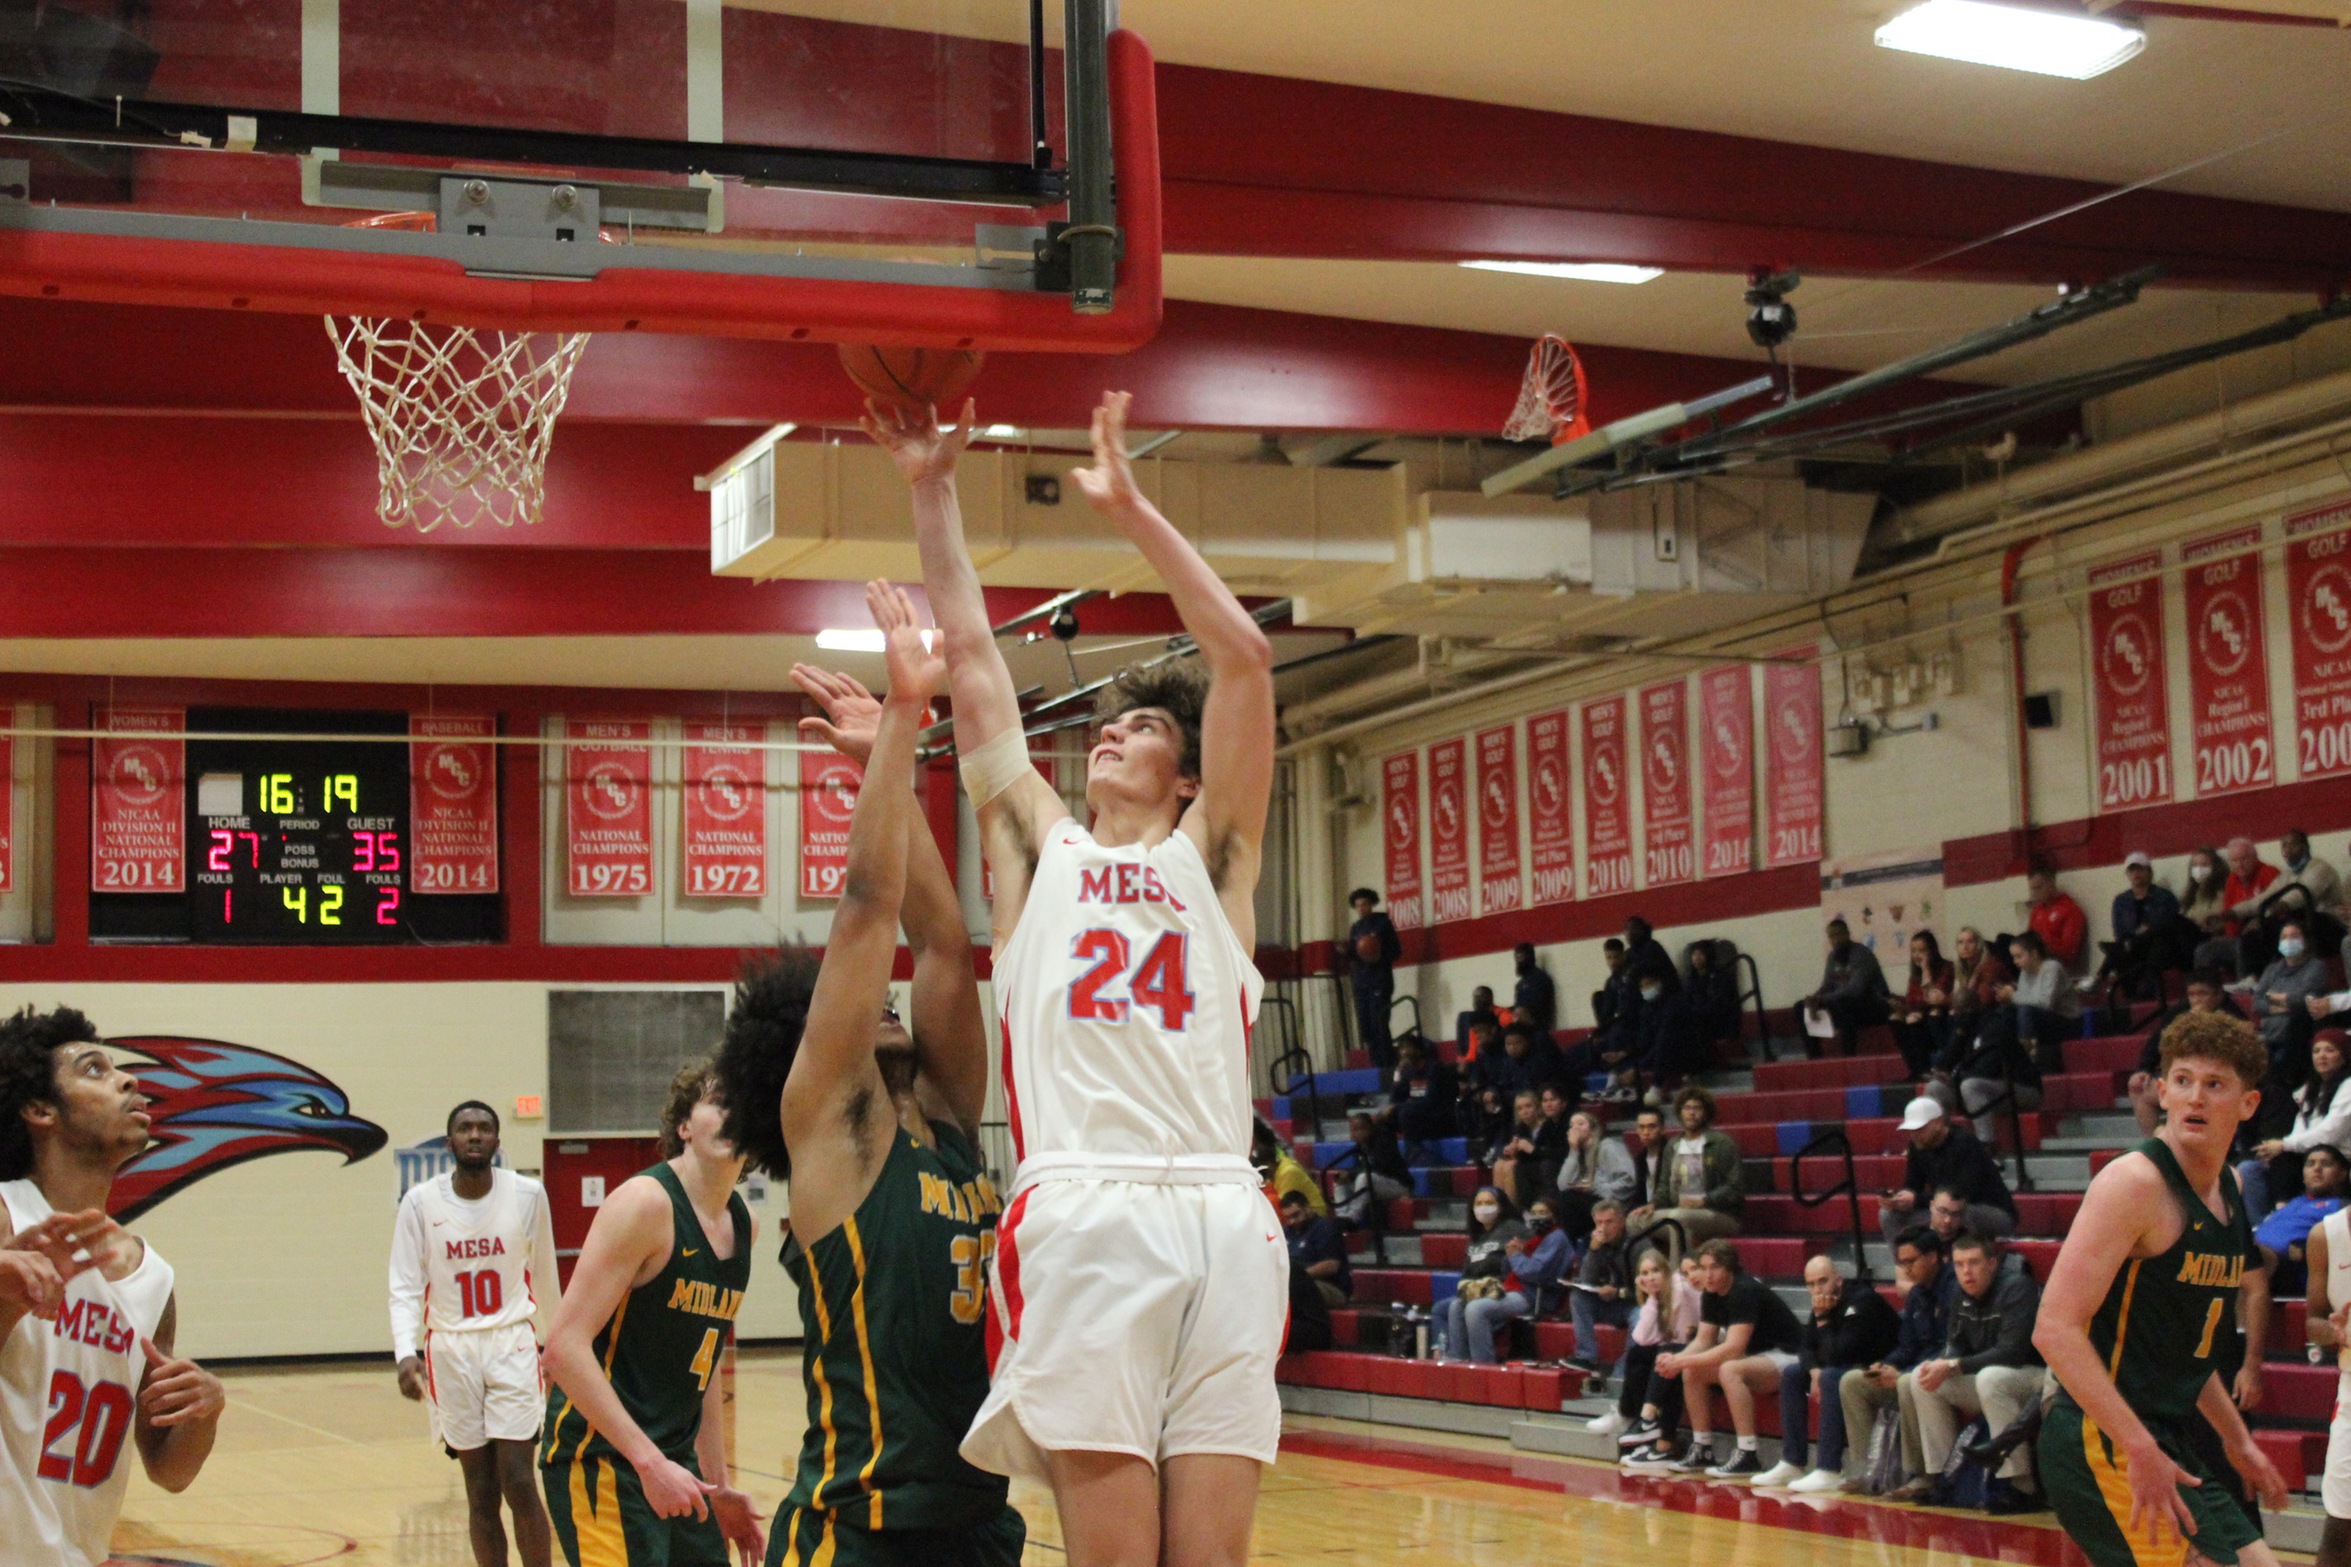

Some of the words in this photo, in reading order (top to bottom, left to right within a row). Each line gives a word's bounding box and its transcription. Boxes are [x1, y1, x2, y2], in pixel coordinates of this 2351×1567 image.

[421, 722, 484, 734] BASEBALL
[586, 725, 632, 738] MEN'S
[703, 728, 747, 740] MEN'S
[2199, 738, 2271, 790] 2002
[2102, 754, 2168, 804] 2001
[102, 822, 163, 833] DIVISION
[208, 817, 251, 830] HOME
[280, 820, 320, 830] PERIOD
[347, 818, 395, 830] GUEST
[579, 830, 643, 841] NATIONAL
[105, 834, 174, 846] NATIONAL
[422, 832, 485, 844] NATIONAL
[573, 843, 649, 855] CHAMPIONS
[695, 831, 756, 843] NATIONAL
[809, 832, 850, 844] NATIO
[1774, 824, 1821, 860] 2014
[99, 847, 180, 860] CHAMPIONS
[209, 829, 259, 871] 27
[284, 845, 316, 856] POSS
[352, 831, 400, 872] 35
[688, 844, 763, 856] CHAMPIONS
[103, 861, 175, 887] 2014
[281, 857, 320, 869] BONUS
[1590, 855, 1632, 894] 2010
[1647, 844, 1691, 883] 2010
[197, 874, 234, 884] FOULS
[260, 873, 303, 885] PLAYER
[317, 874, 346, 885] FOUL
[365, 874, 401, 885] FOULS
[421, 863, 488, 888] 2014
[576, 864, 647, 891] 1975
[691, 864, 761, 892] 1972
[1533, 865, 1572, 902] 2009
[224, 888, 232, 924] 1
[376, 886, 400, 925] 2
[1483, 876, 1520, 912] 2009
[1067, 927, 1197, 1033] 24
[446, 1236, 506, 1260] MESA
[454, 1268, 503, 1319] 10
[2193, 1298, 2224, 1359] 1
[688, 1327, 720, 1392] 4
[37, 1368, 136, 1490] 20
